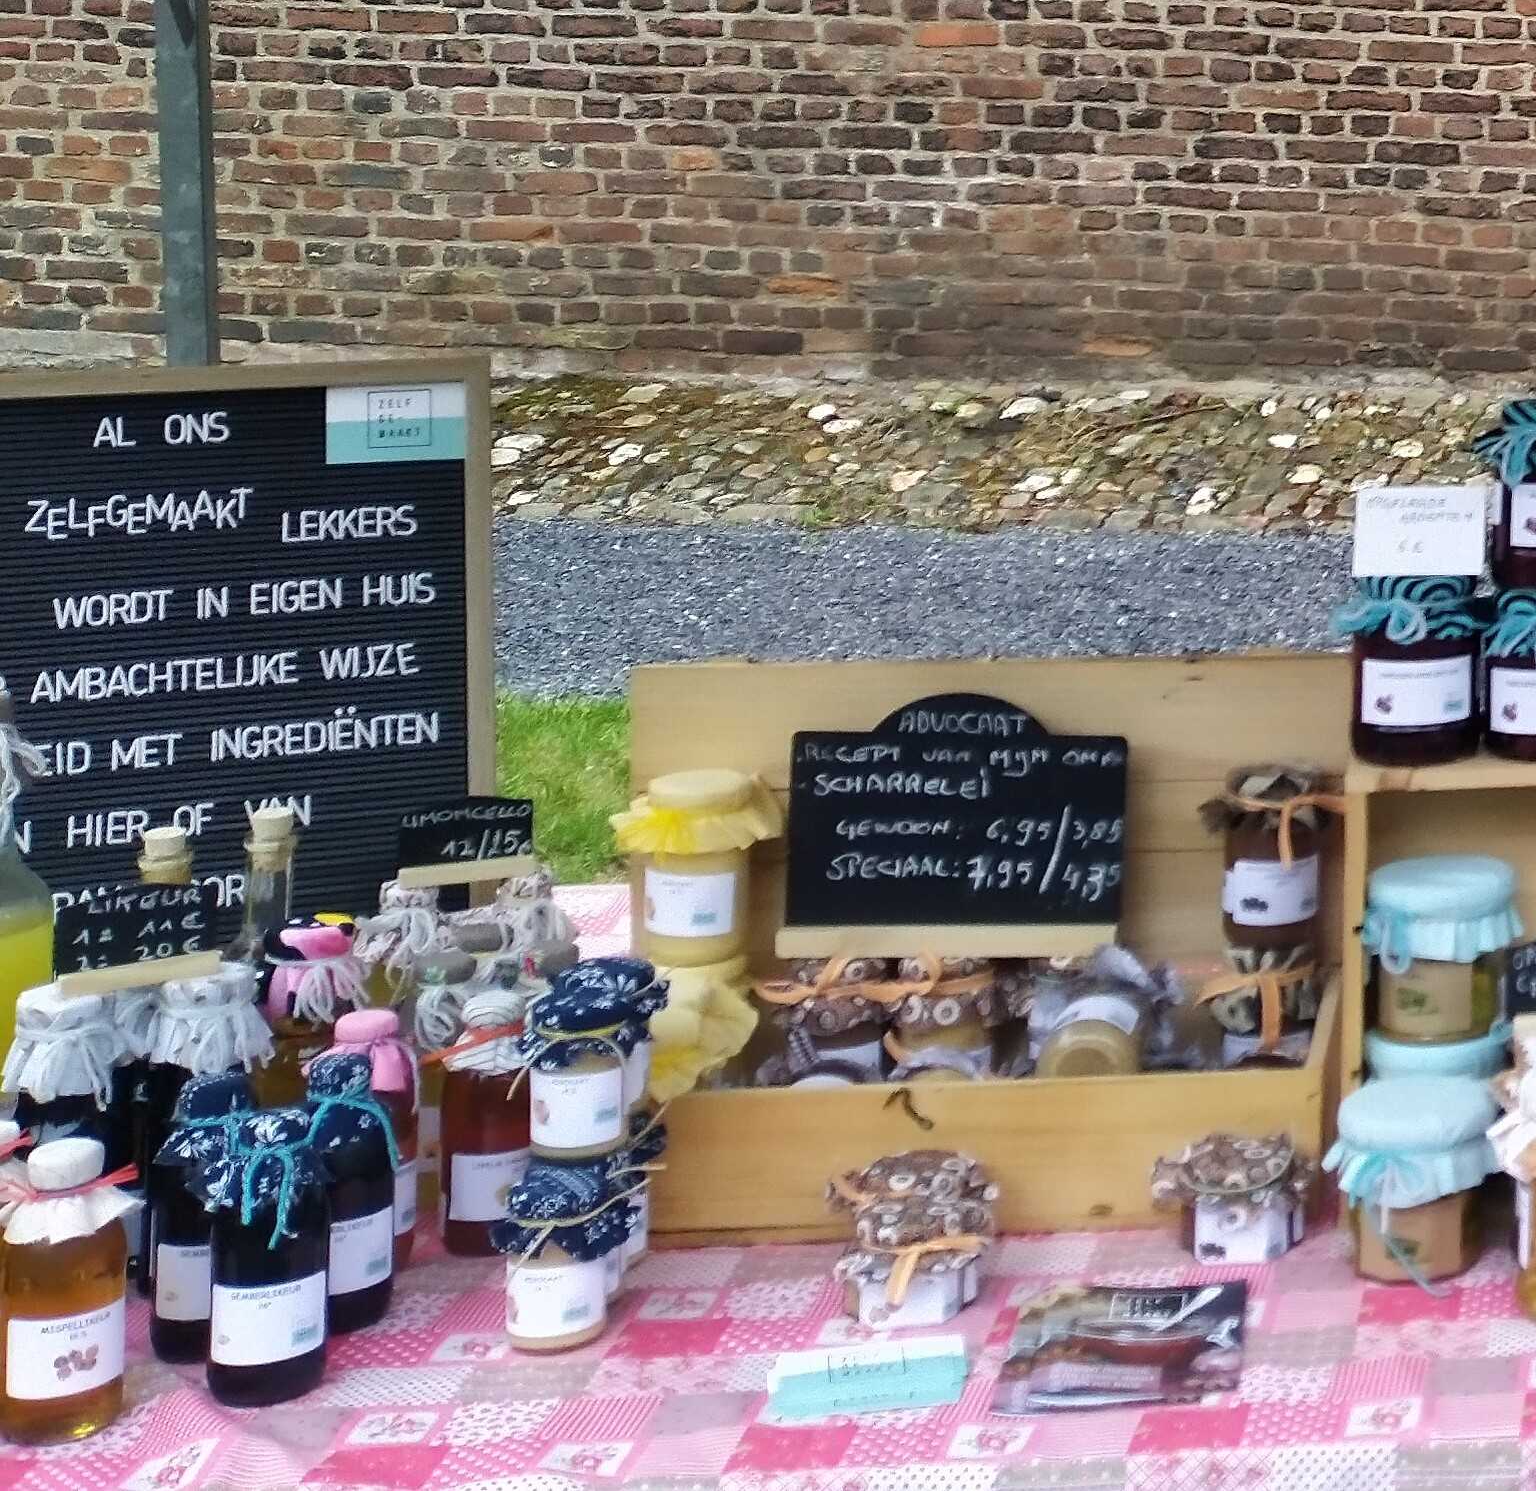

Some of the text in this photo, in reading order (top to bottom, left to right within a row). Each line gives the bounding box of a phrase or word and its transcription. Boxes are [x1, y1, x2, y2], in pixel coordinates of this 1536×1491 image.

[93, 412, 231, 448] AL ONS
[24, 487, 418, 545] ZELFGEMAAKT LEKKERS
[52, 571, 436, 631] WORDT IN EIGEN HUIS
[30, 653, 299, 704] AMBACHTELIJKE
[320, 642, 418, 682] WIJZE
[110, 732, 184, 772] MET
[210, 705, 439, 764] INGREDIËNTEN
[898, 709, 1028, 736] ADVOCAAT
[66, 809, 148, 848] HIER
[172, 803, 214, 837] OF
[244, 794, 313, 828] VN
